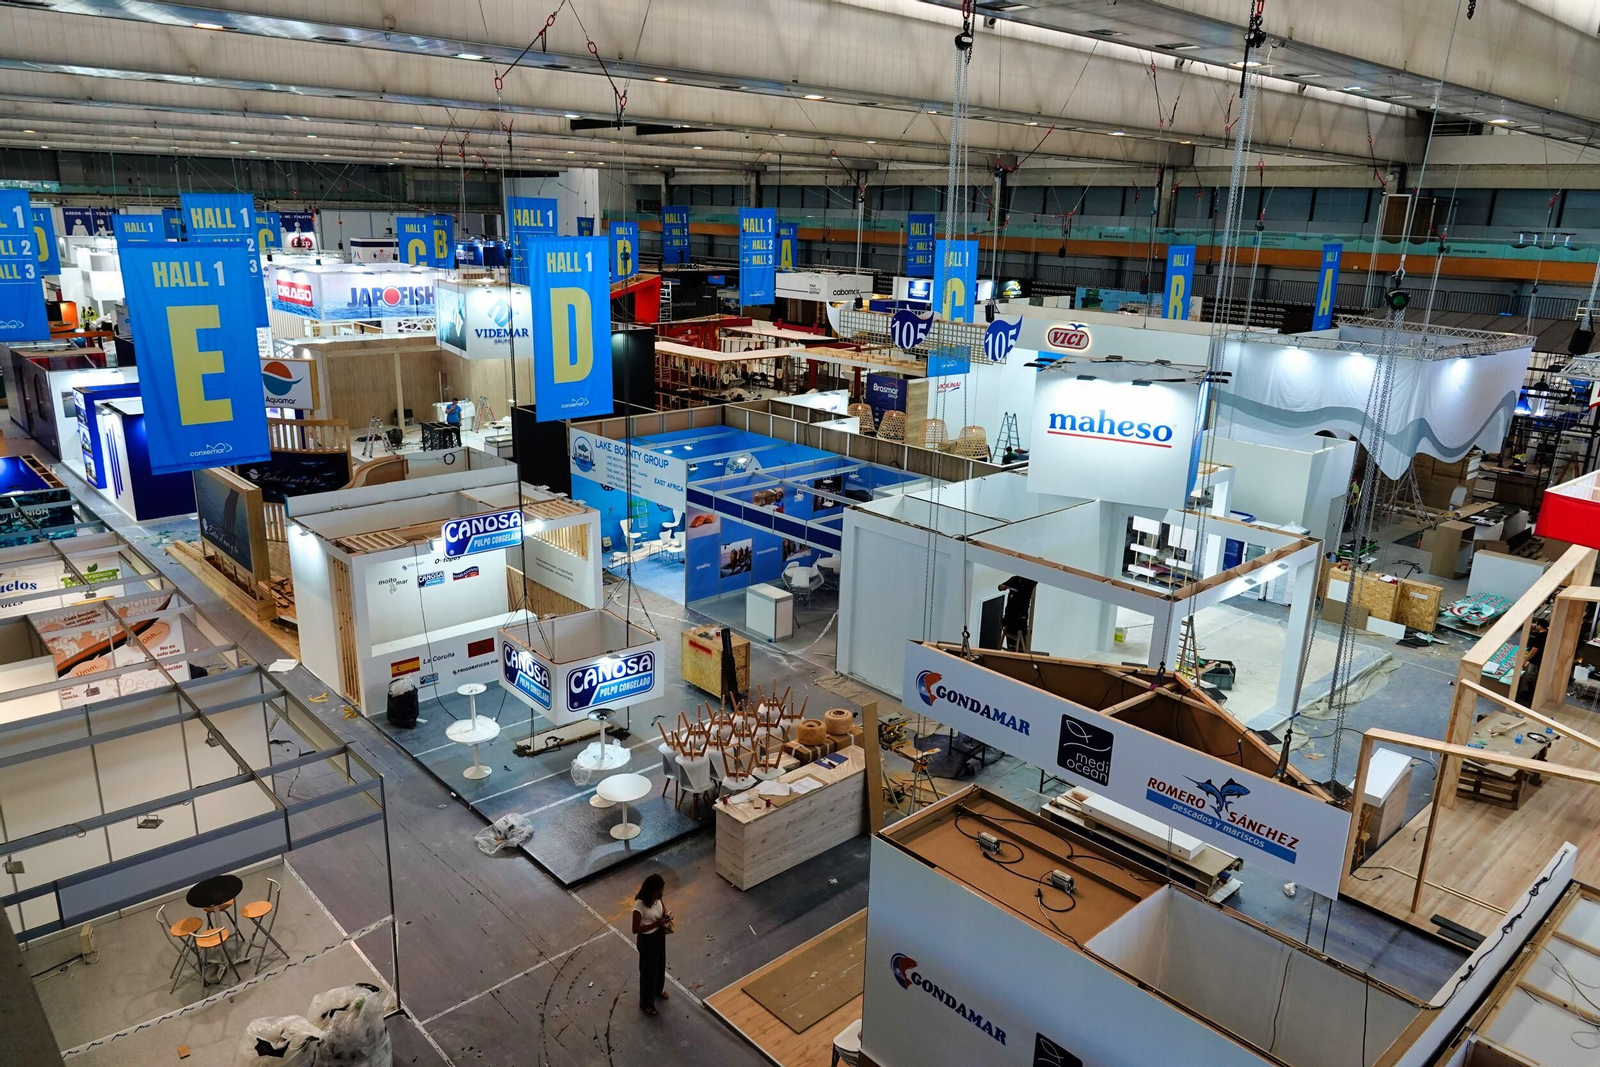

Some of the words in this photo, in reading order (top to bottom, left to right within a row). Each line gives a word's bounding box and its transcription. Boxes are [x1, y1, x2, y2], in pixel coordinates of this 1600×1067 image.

[13, 206, 25, 228] 1
[190, 208, 236, 228] HALL
[240, 207, 250, 228] 1
[513, 209, 544, 227] HALL
[547, 210, 554, 227] 1
[665, 213, 682, 224] HALL
[683, 213, 687, 224] 1
[743, 218, 766, 232] HALL
[767, 218, 772, 232] 1
[124, 222, 146, 233] HALL
[148, 222, 153, 233] 1
[405, 224, 421, 233] HALL
[423, 224, 427, 233] 1
[616, 227, 629, 235] HALL
[629, 227, 633, 235] 1
[672, 228, 683, 236] HALL
[684, 228, 688, 236] 2
[910, 223, 927, 236] HALL
[928, 223, 933, 235] 1
[21, 240, 32, 255] 2
[246, 238, 255, 252] 2
[434, 230, 448, 259] B
[673, 238, 684, 247] HALL
[684, 238, 689, 247] 3
[752, 240, 767, 250] HALL
[768, 240, 773, 250] 2
[916, 242, 928, 250] HALL
[547, 252, 582, 273] HALL
[585, 252, 593, 272] 1
[752, 255, 767, 265] HALL
[768, 255, 773, 265] 3
[781, 239, 792, 270] A
[916, 256, 927, 264] HALL
[928, 255, 932, 263] 3
[1186, 254, 1190, 266] 1
[25, 264, 35, 279] 3
[152, 261, 209, 287] HALL
[213, 261, 225, 286] 1
[249, 259, 258, 273] 3
[277, 285, 312, 302] DRAGO
[1318, 269, 1333, 316] A
[475, 328, 529, 338] VIDEMAR
[550, 287, 594, 384] D
[892, 321, 927, 349] 105
[1050, 331, 1086, 347] VICI
[985, 328, 1017, 361] 105
[166, 305, 233, 425] E
[873, 383, 899, 395] Brasmar
[265, 396, 296, 405] Aquamar
[1049, 409, 1173, 442] maheso
[189, 447, 225, 458] conxemar
[595, 439, 612, 452] LAKE
[643, 454, 669, 469] GROUP
[654, 478, 666, 486] EAST
[667, 482, 684, 493] AFRICA
[445, 512, 521, 543] CANOSA
[473, 538, 491, 548] PULPO
[378, 577, 397, 586] moito
[423, 657, 432, 665] La
[432, 652, 455, 662] Coruña
[505, 645, 549, 688] CANOSA
[570, 654, 652, 694] CANOSA
[600, 684, 618, 698] PULPO
[619, 676, 651, 692] CONGELADO
[936, 686, 1031, 736] GONDAMAR
[1066, 758, 1108, 784] ocean
[1075, 752, 1109, 774] medi
[1147, 777, 1206, 809] ROMERO
[1227, 811, 1300, 850] SÁNCHEZ
[1172, 802, 1213, 825] pescados
[1215, 821, 1221, 829] y
[1222, 824, 1265, 848] mariscos
[911, 972, 1007, 1046] GONDAMAR
